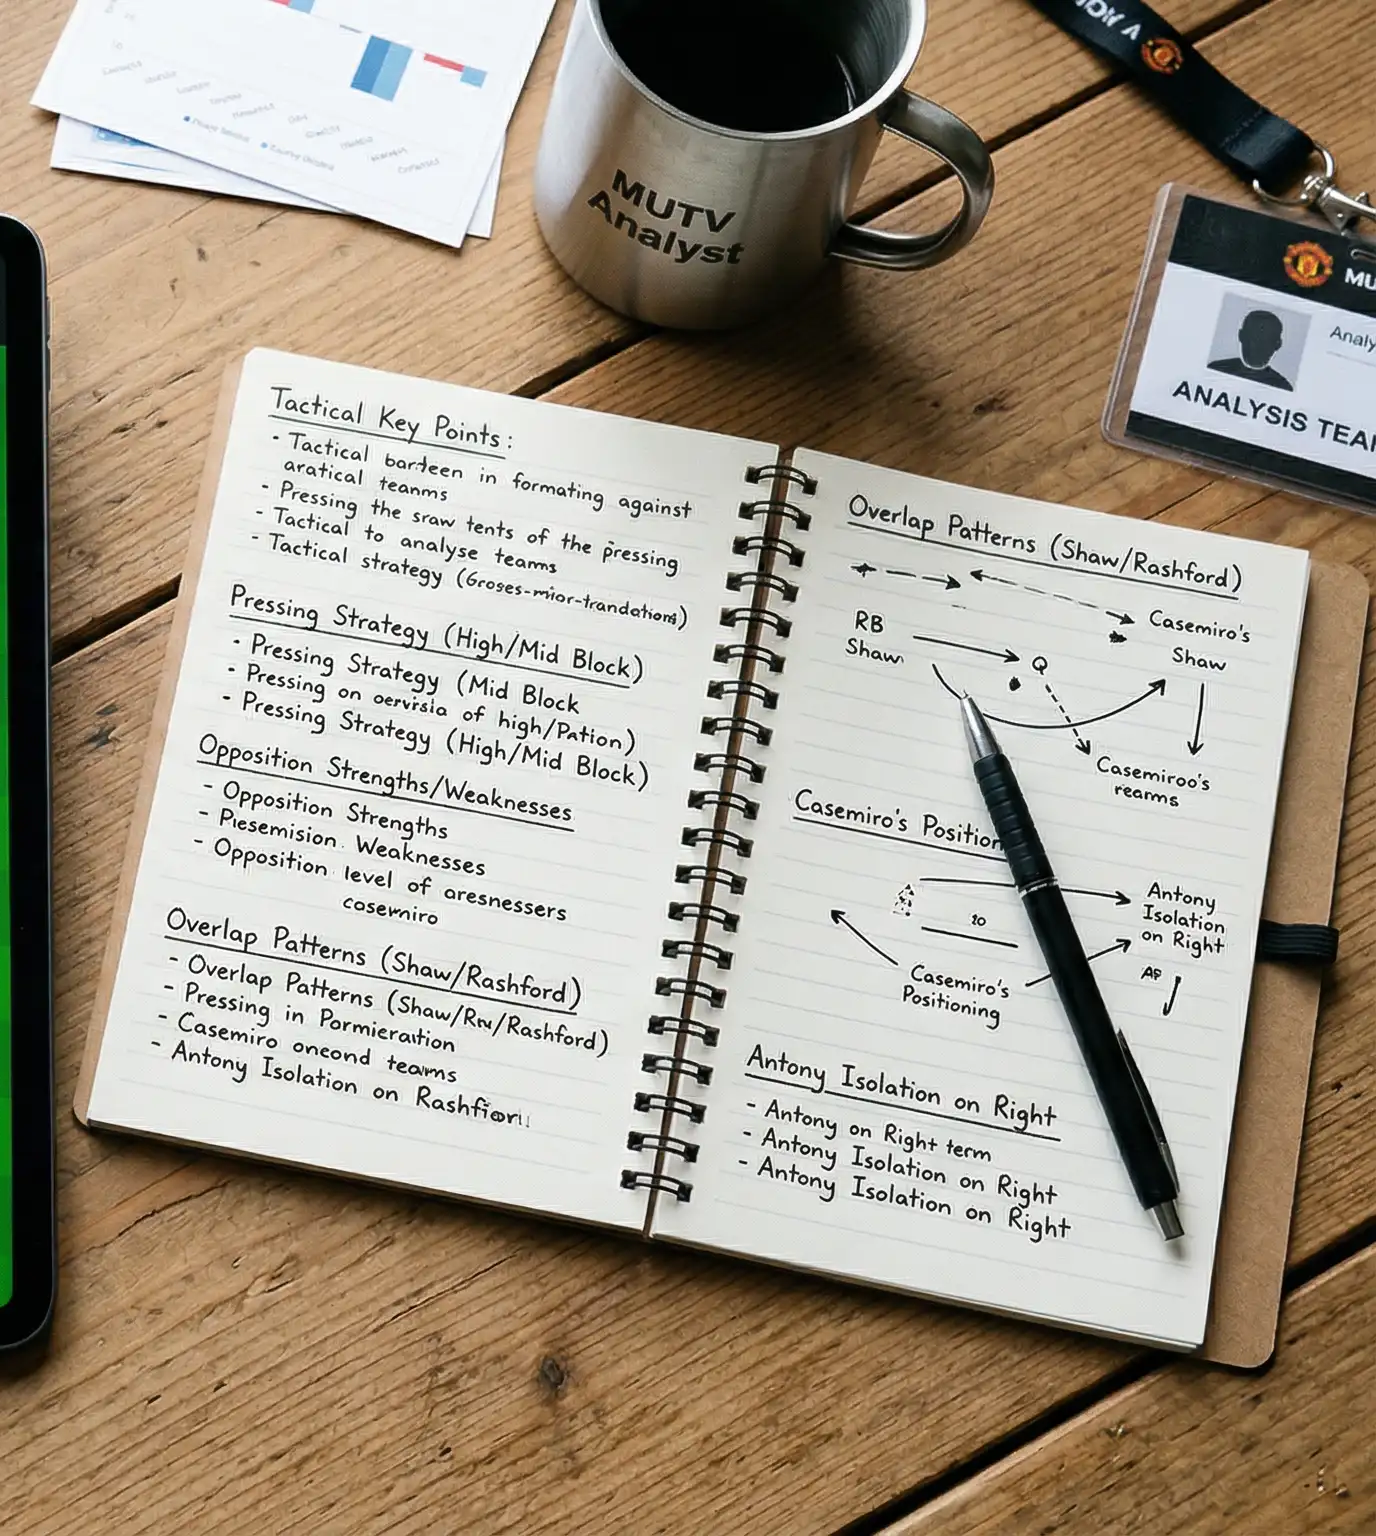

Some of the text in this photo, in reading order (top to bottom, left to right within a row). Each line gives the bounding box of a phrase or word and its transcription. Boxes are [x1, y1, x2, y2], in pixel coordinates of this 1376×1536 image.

[588, 190, 744, 264] Analyst
[611, 169, 736, 233] MUTV
[271, 387, 363, 424] Tactical
[379, 405, 420, 444] Key
[1172, 381, 1376, 452] ANALYSIS TEA
[284, 460, 363, 485] aratical
[289, 432, 369, 462] Tactical
[480, 468, 497, 484] in
[513, 472, 604, 511] formating
[619, 497, 692, 518] against
[274, 507, 349, 535] Tactical
[364, 524, 384, 542] to
[401, 537, 478, 562] analyse
[280, 480, 357, 519] Pressing
[371, 499, 401, 519] the
[467, 516, 513, 539] tents
[527, 528, 550, 545] of
[561, 533, 592, 554] the
[603, 540, 678, 577] pressing
[849, 494, 1242, 593] Overlap Patterns (Shaw/Rashford)
[269, 533, 347, 563] Tactical
[361, 553, 442, 589] strategy
[231, 584, 643, 684] Pressing Strategy (High/Mid Block)
[855, 610, 883, 634] RB
[1149, 610, 1250, 643] Casemiro's
[252, 633, 579, 714] Pressing Strategy (Mid Block
[1172, 647, 1226, 671] Shaw
[248, 663, 325, 703] Pressing
[339, 689, 361, 700] on
[463, 706, 486, 722] of
[243, 691, 648, 792] Pressing Strategy (High/Mid Block)
[200, 734, 572, 821] Opposition Strengths/Weaknesses
[1096, 757, 1210, 792] Casemiroo's
[224, 781, 448, 840] Opposition Strengths
[795, 789, 908, 832] Casemiro's
[214, 838, 327, 876] Opposition
[345, 866, 392, 888] level
[408, 877, 431, 894] of
[357, 835, 486, 875] Weaknesses
[1143, 904, 1225, 934] Isolation
[1148, 882, 1215, 915] Antony
[168, 907, 581, 1010] Overlap Patterns (Shaw/Rashford)
[1142, 931, 1224, 958] on Right
[186, 982, 270, 1027] Pressing
[286, 1005, 304, 1024] in
[189, 954, 272, 994] Overlap
[287, 972, 373, 1008] Patterns
[903, 985, 1000, 1029] Positioning
[911, 965, 1009, 998] Casemiro's
[178, 1012, 277, 1048] Casemiro
[172, 1040, 247, 1083] Antony
[262, 1055, 357, 1095] Isolation
[373, 1087, 398, 1101] on
[747, 1044, 1057, 1133] Antony Isolation on Right
[765, 1099, 992, 1162] Antony on Right term
[761, 1128, 1058, 1209] Antony Isolation on Right
[757, 1156, 1071, 1243] Antony Isolation on Right
